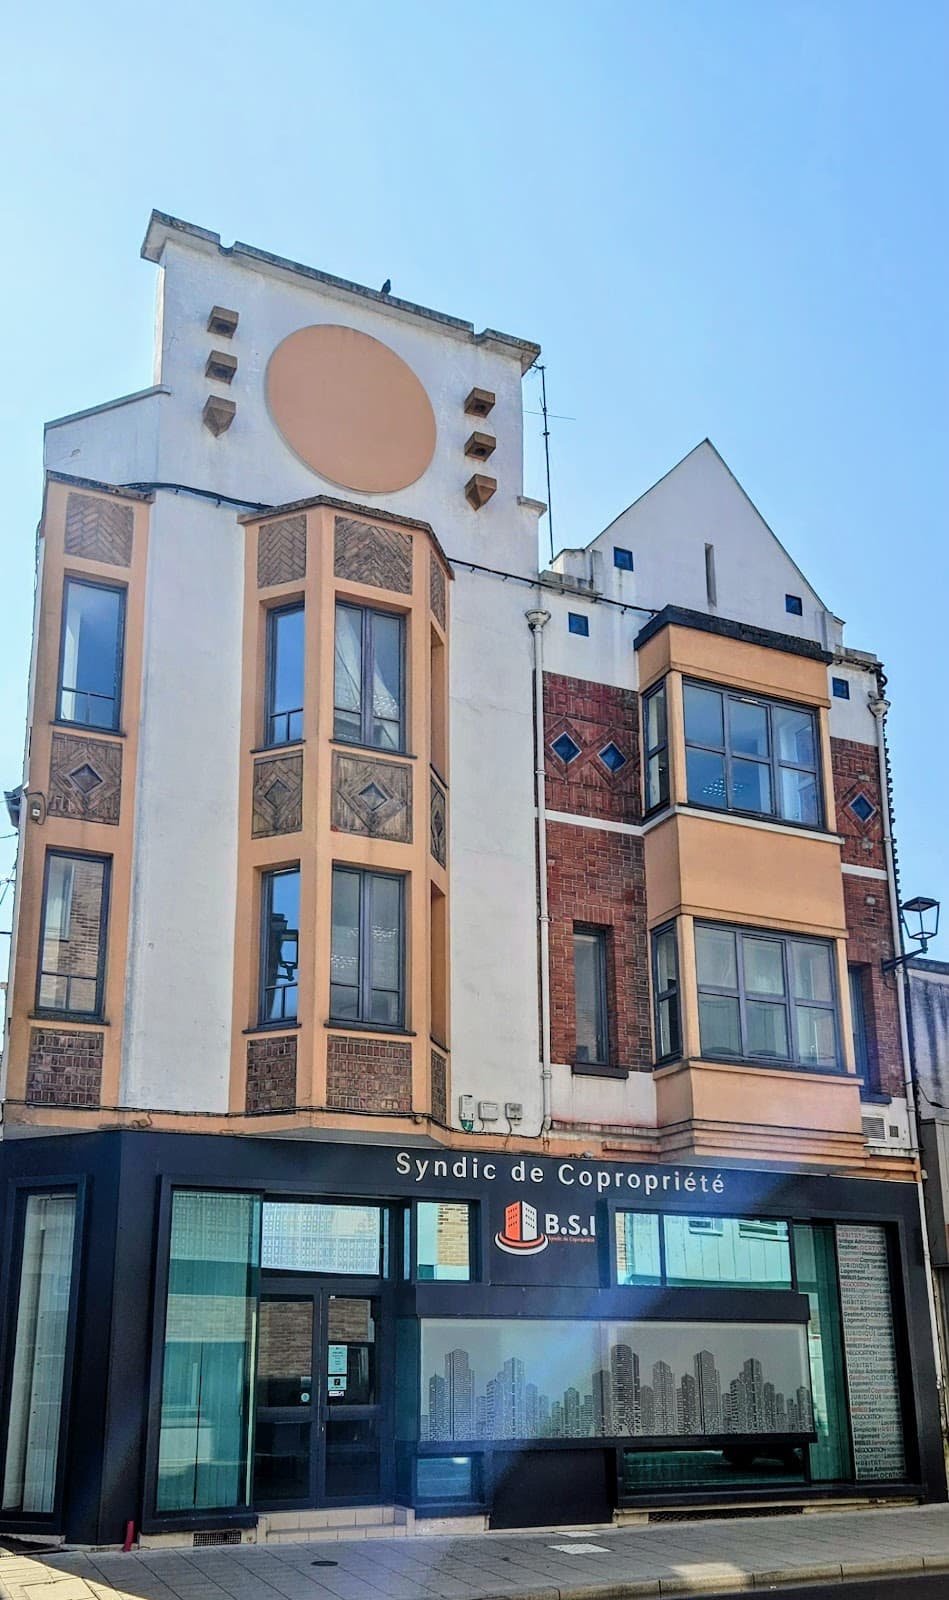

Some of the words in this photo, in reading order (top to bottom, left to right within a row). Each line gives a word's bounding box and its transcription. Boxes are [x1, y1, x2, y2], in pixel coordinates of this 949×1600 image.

[396, 1151, 497, 1182] Syndic
[511, 1160, 545, 1183] de
[558, 1163, 725, 1196] Copropriété
